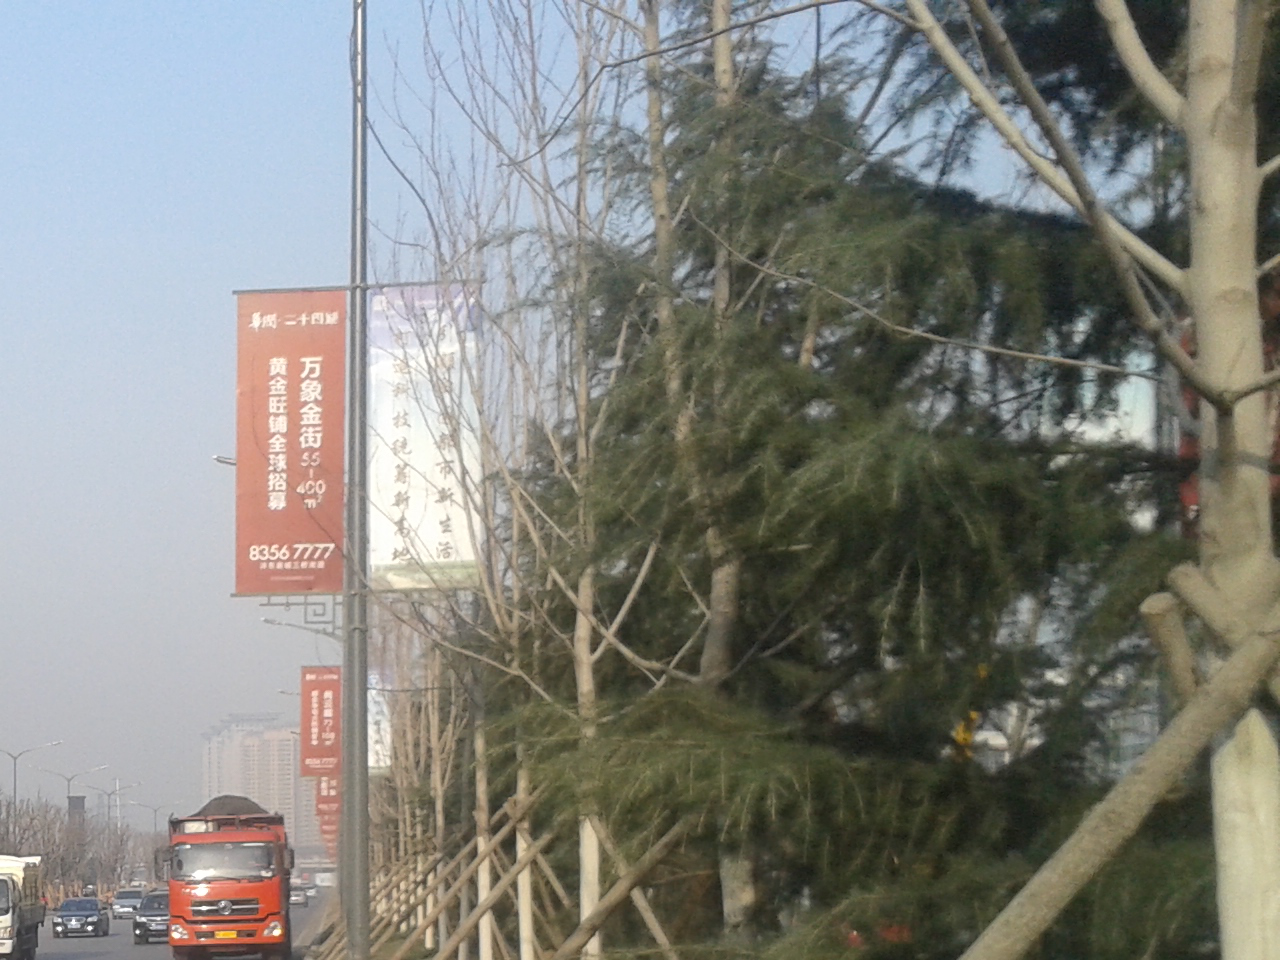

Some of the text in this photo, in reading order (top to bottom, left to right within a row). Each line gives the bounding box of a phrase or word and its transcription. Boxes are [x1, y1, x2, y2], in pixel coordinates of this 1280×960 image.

[267, 357, 288, 511] 黄金旺铺全球招募
[299, 356, 323, 449] 万象金街
[249, 543, 336, 561] 8356 7777
